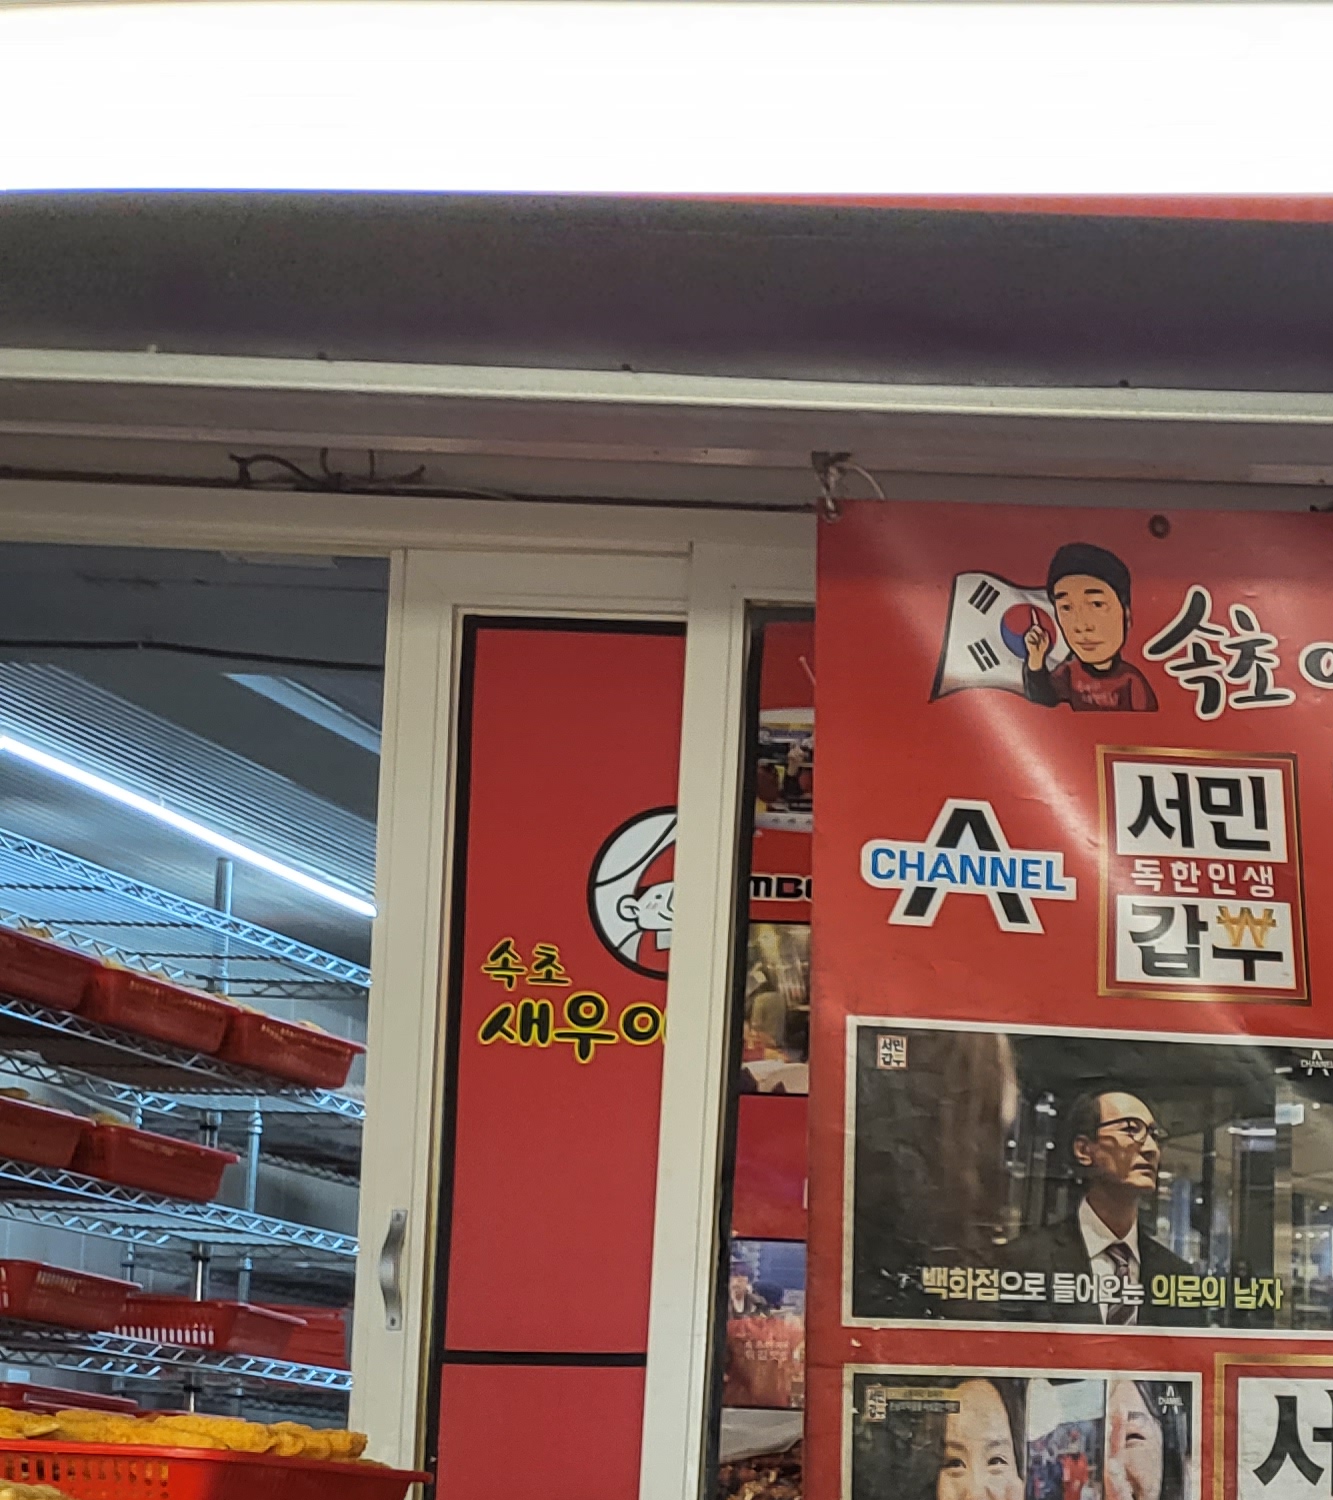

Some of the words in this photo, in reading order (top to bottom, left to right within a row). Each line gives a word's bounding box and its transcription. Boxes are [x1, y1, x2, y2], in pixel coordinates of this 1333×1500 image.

[1143, 584, 1296, 721] 속초
[1128, 772, 1271, 852] 서민
[871, 847, 1067, 892] CHANNEL
[481, 937, 572, 991] 속초
[922, 1266, 1047, 1301] 백화점으로
[1052, 1272, 1144, 1306] 들어오는
[1151, 1274, 1226, 1309] 의문의
[1233, 1277, 1284, 1311] 남자
